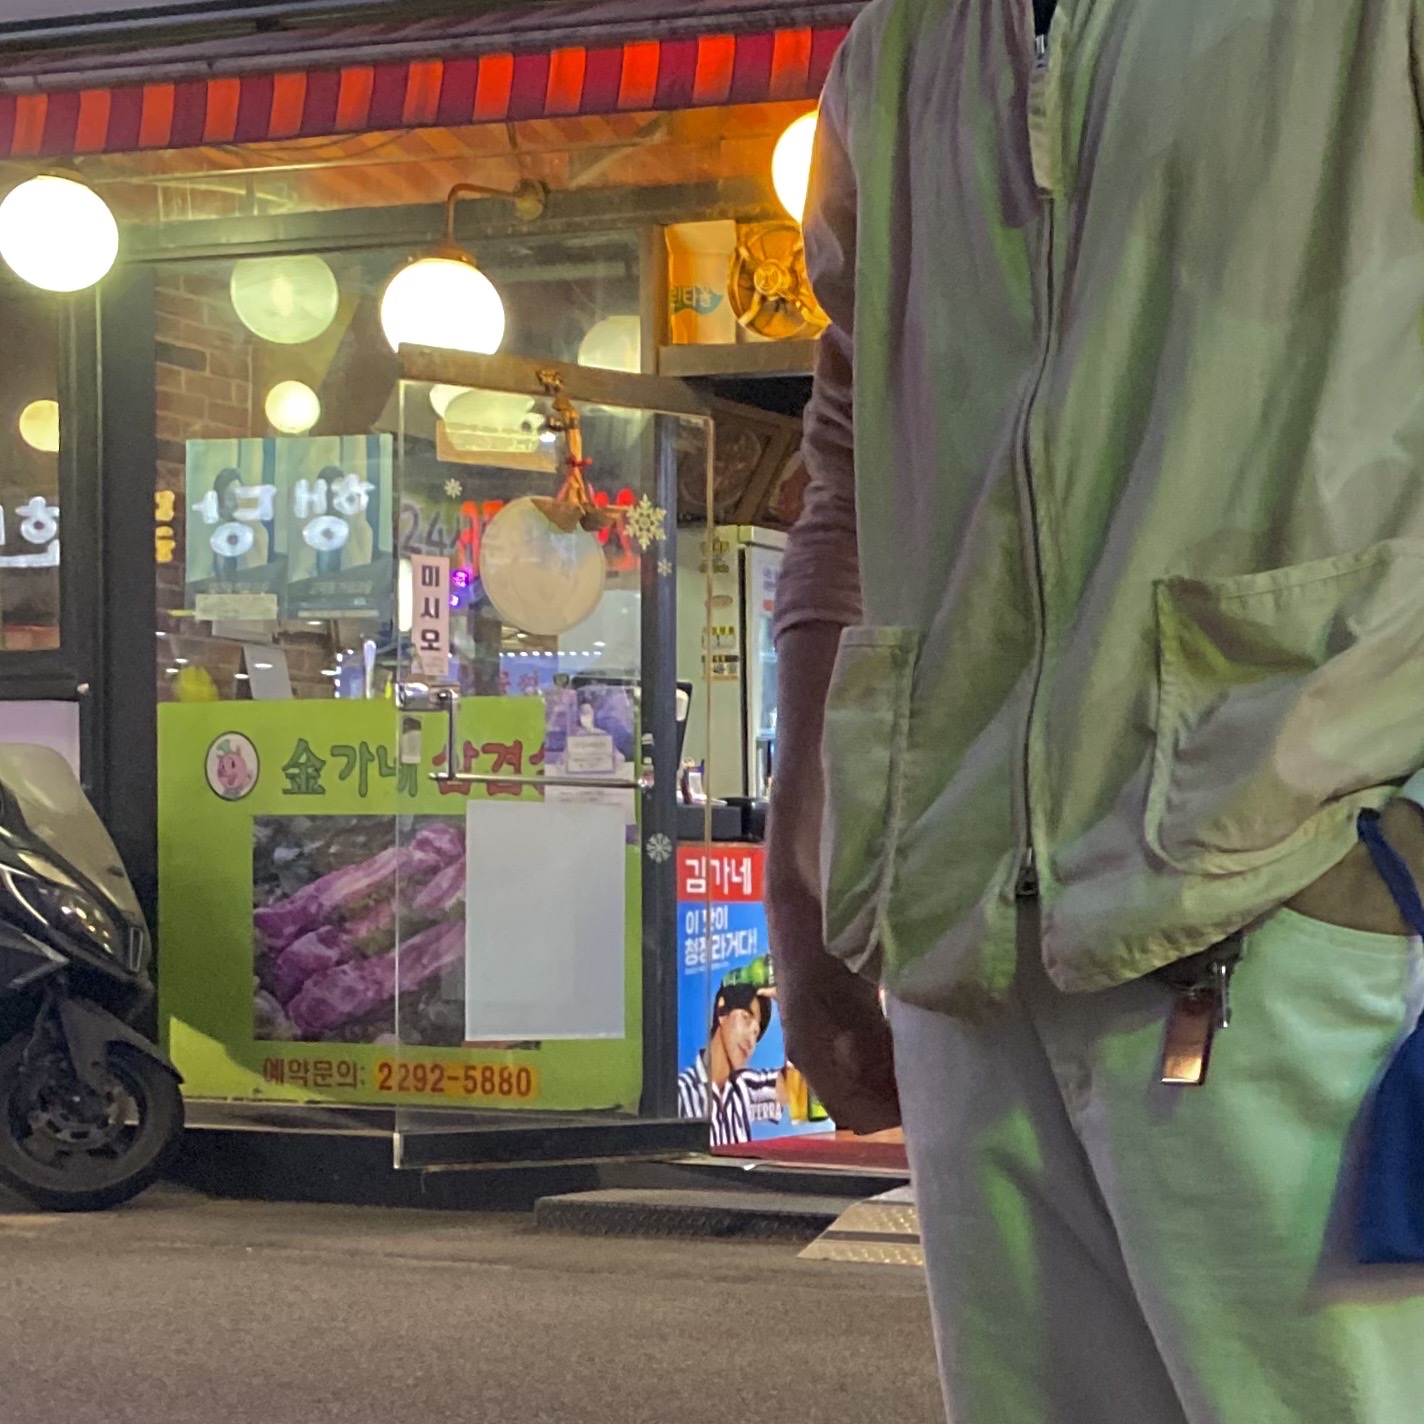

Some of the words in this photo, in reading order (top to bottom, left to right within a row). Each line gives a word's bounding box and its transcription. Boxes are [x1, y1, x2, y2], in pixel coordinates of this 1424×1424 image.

[418, 564, 440, 652] 미시오
[685, 855, 752, 896] 김가네
[378, 1062, 532, 1098] 2292-5880
